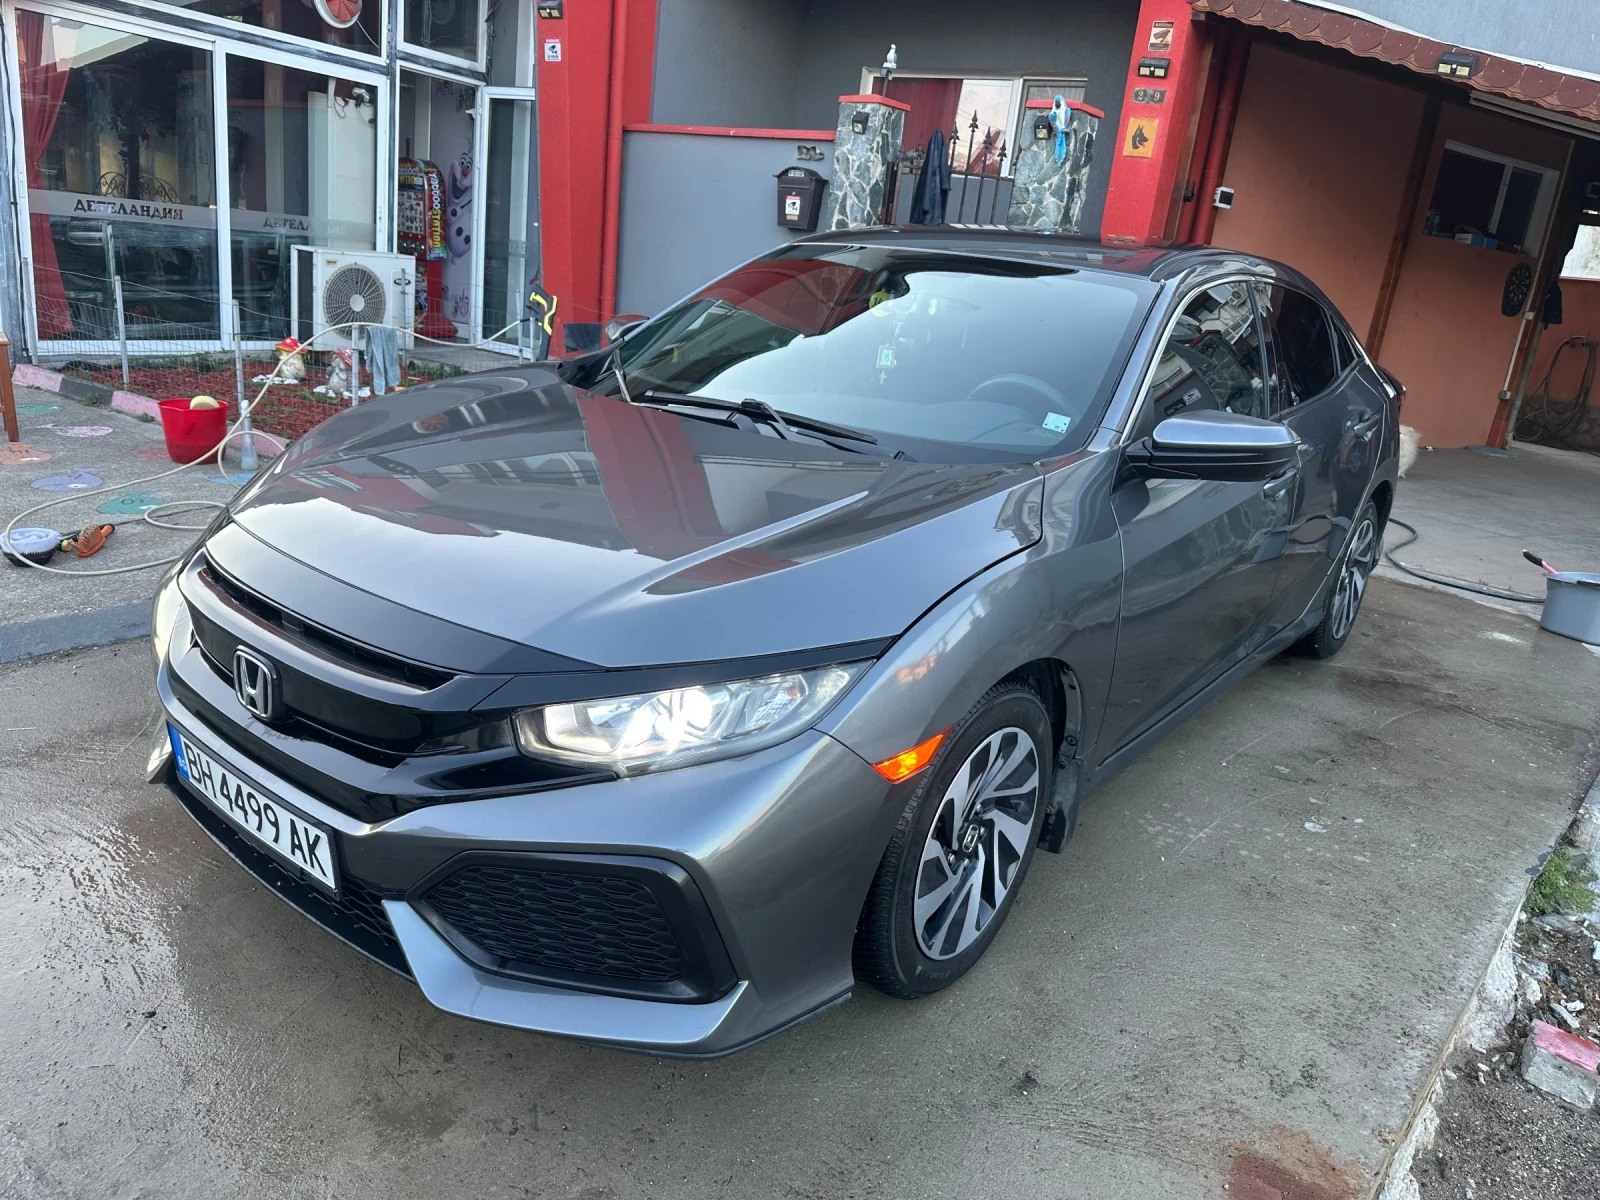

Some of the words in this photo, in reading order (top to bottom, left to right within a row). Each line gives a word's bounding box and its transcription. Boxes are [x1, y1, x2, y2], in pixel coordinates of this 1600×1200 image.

[74, 199, 183, 220] ДЕТЕЛАНДИЯ
[183, 741, 217, 799] BH
[220, 772, 280, 844] 4499
[290, 818, 328, 878] AK
